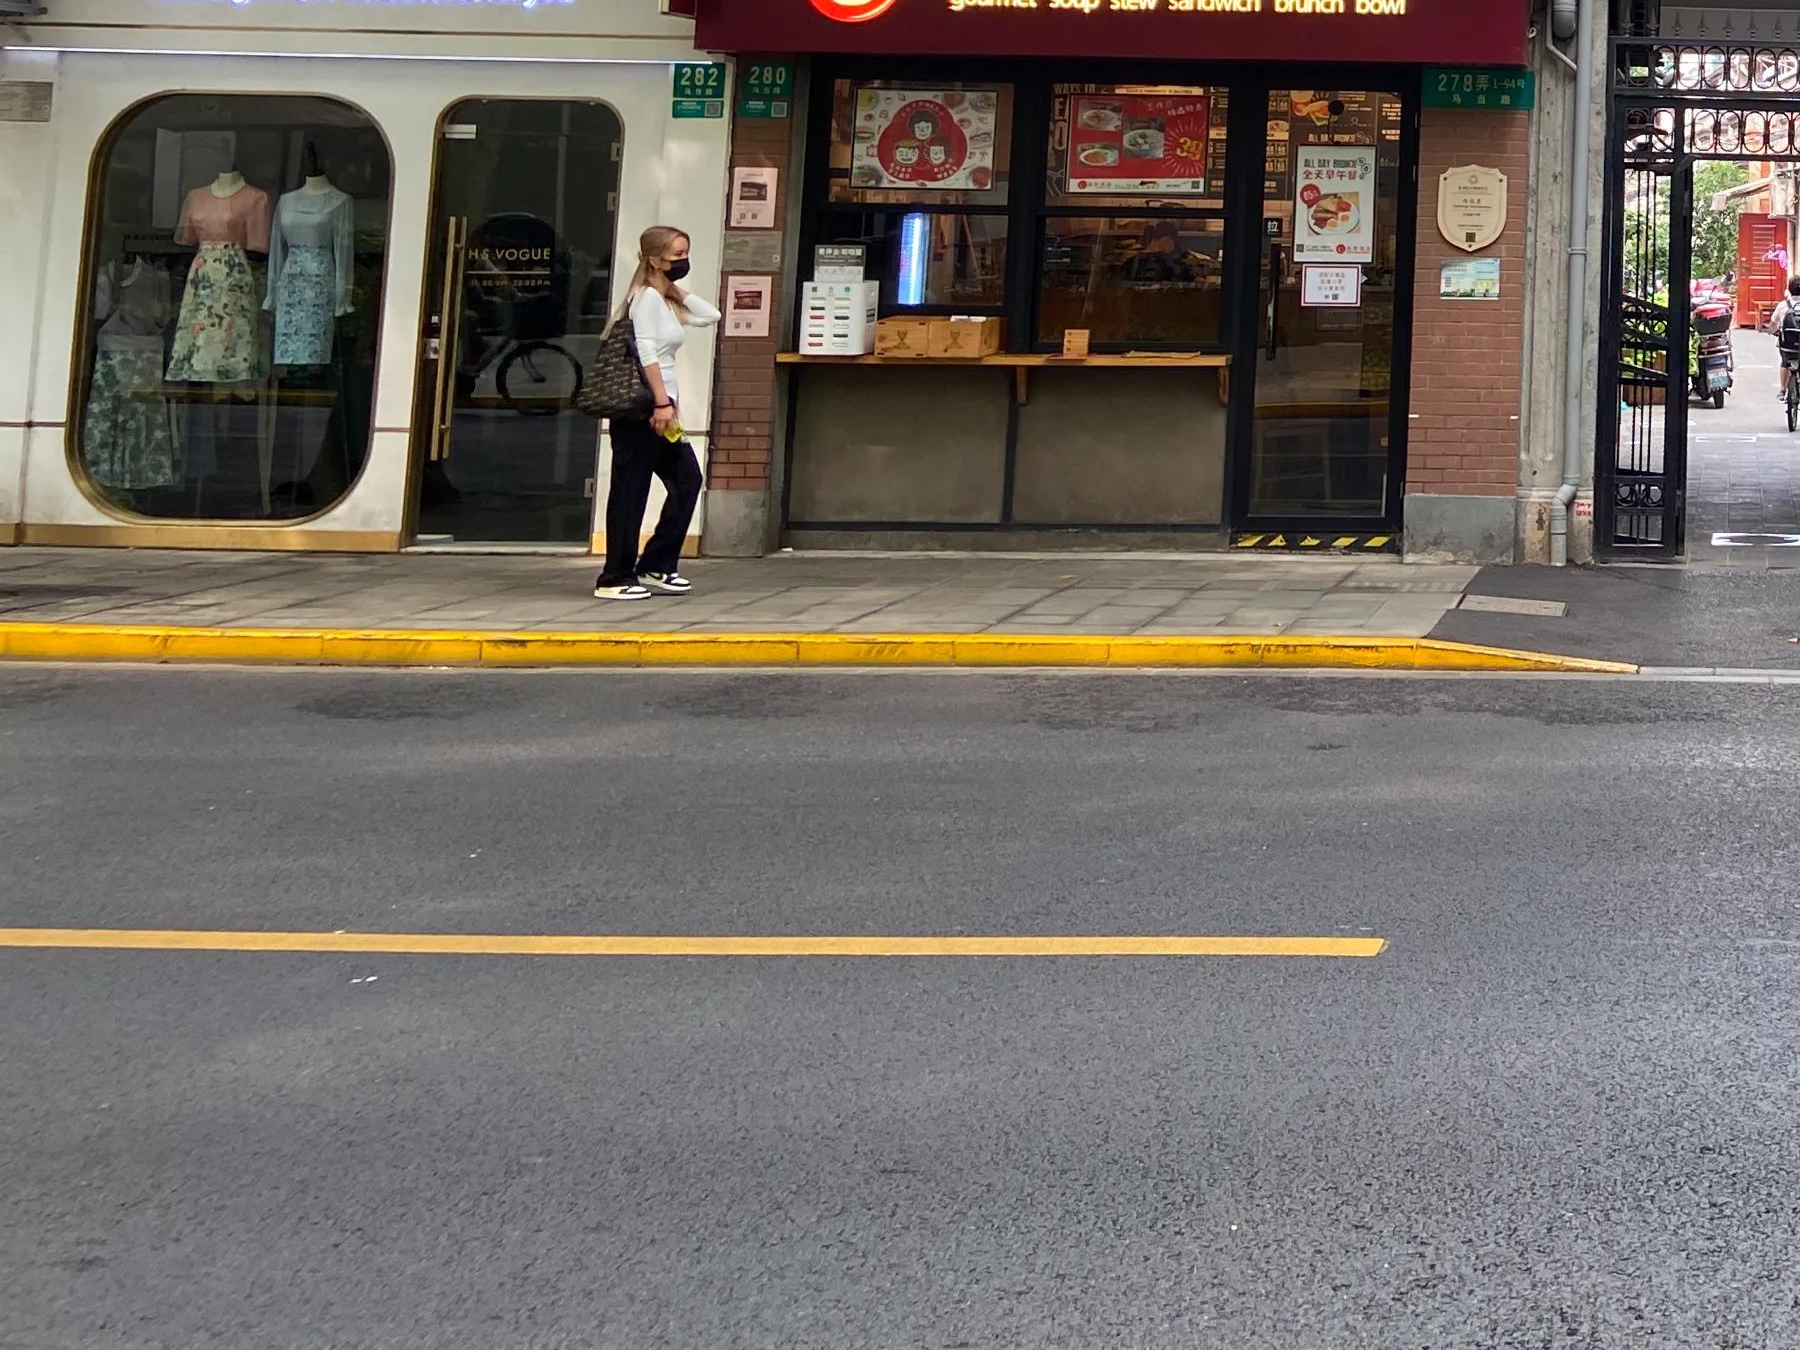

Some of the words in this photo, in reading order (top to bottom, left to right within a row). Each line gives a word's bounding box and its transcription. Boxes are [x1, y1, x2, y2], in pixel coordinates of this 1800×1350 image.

[680, 66, 718, 86] 282
[748, 66, 786, 85] 280
[495, 248, 551, 261] VOGUE
